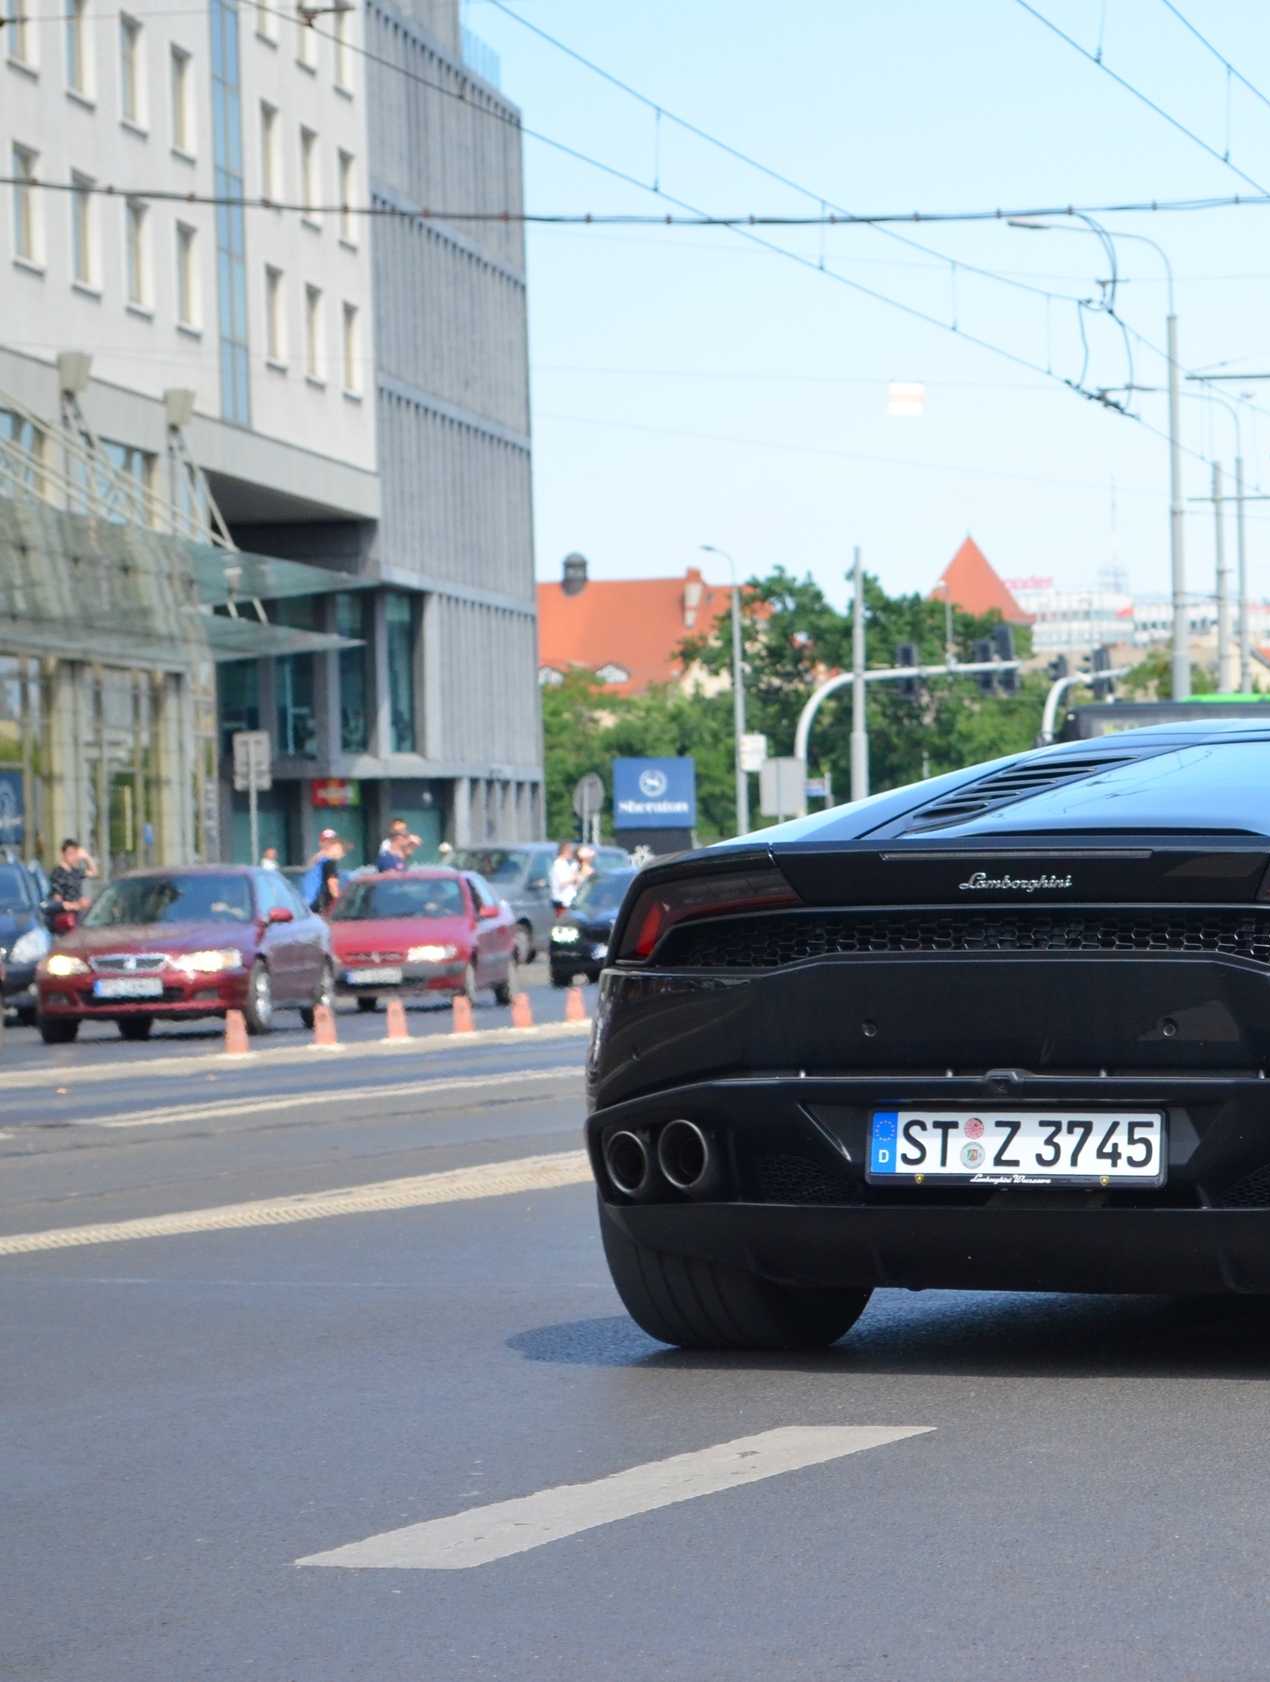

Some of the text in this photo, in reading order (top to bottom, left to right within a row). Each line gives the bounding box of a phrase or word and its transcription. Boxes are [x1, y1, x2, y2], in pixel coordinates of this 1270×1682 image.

[959, 872, 1072, 892] Lamborghini
[900, 1119, 1154, 1168] ST Z 3745
[878, 1149, 890, 1164] D
